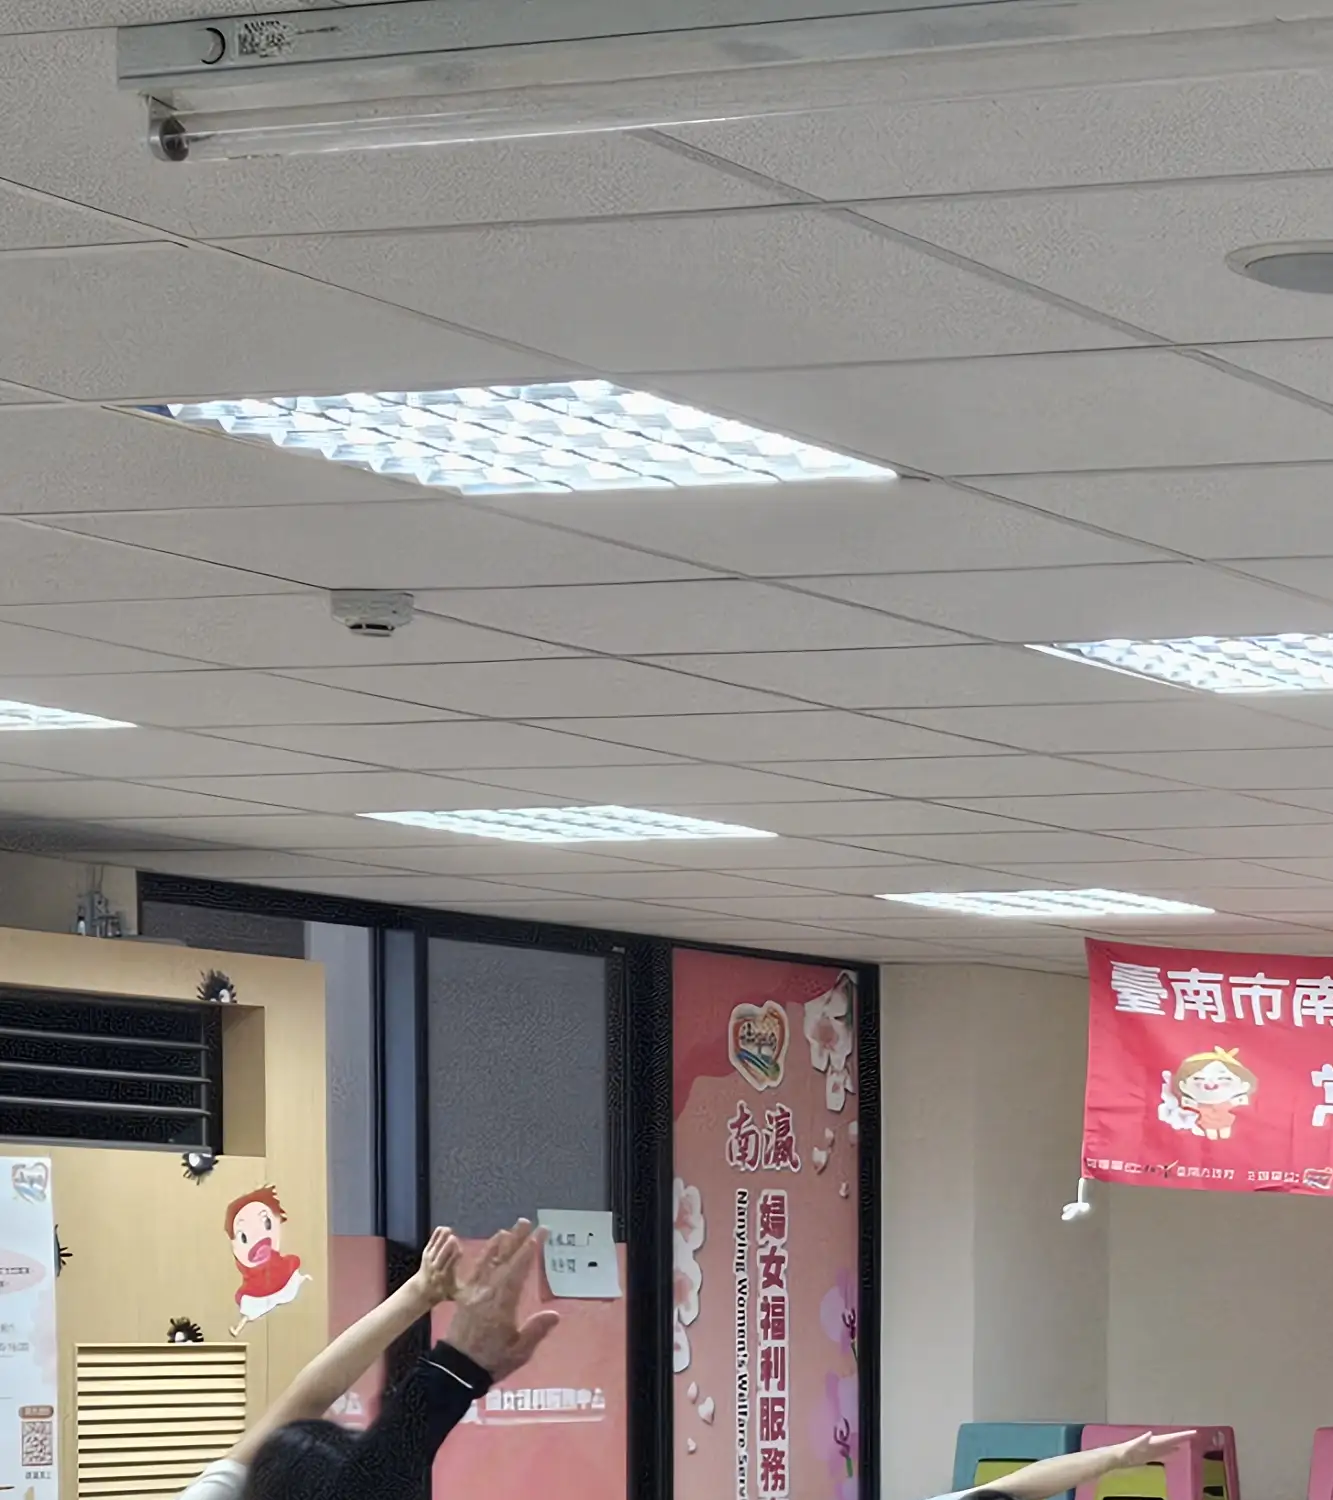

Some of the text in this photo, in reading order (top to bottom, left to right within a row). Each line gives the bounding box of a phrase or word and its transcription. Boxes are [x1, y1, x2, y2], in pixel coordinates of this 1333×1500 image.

[728, 1102, 800, 1170] 南瀛
[735, 1191, 748, 1273] Nanying
[737, 1372, 748, 1449] Welfare
